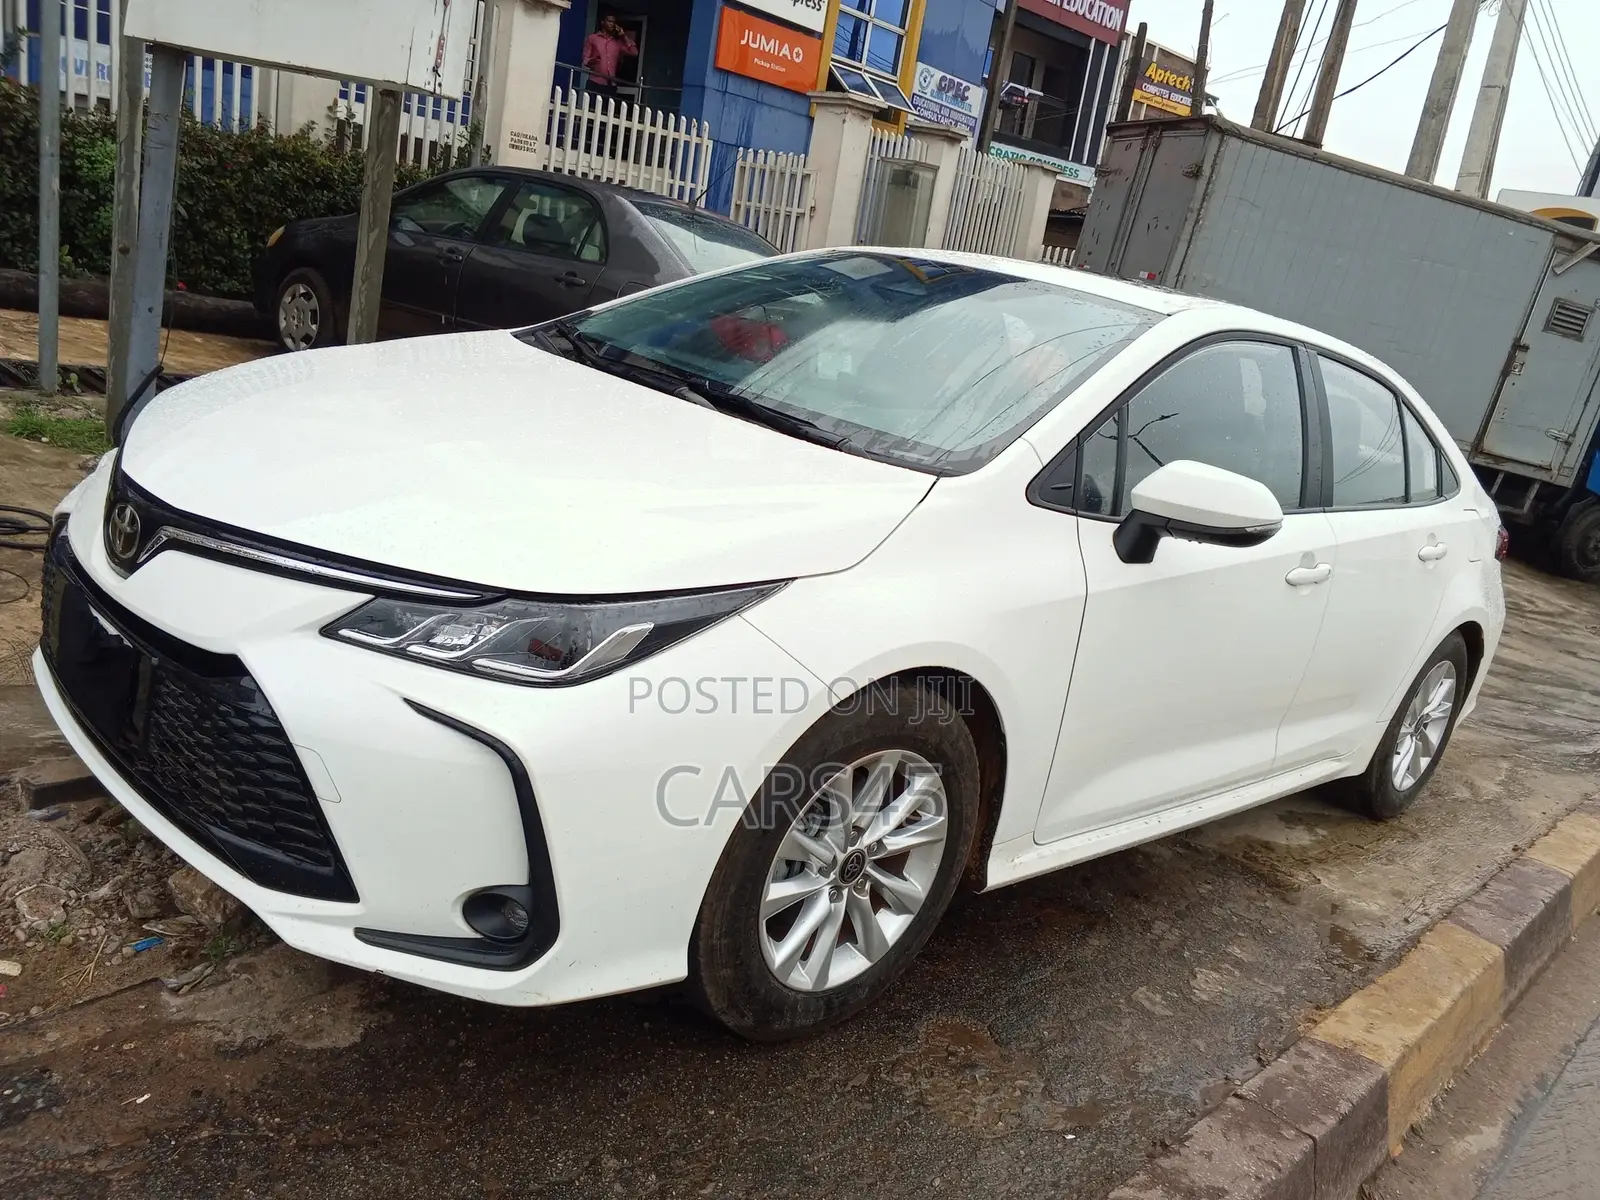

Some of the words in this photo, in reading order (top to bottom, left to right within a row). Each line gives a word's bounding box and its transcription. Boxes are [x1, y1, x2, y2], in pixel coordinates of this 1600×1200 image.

[790, 0, 823, 12] press
[740, 29, 792, 60] JUMIA
[753, 57, 770, 68] Pickup
[770, 62, 786, 73] Station
[1144, 62, 1191, 92] Aptech
[1142, 82, 1170, 99] COMPUTER
[913, 95, 940, 114] EDUCATIONAL
[940, 106, 950, 117] AND
